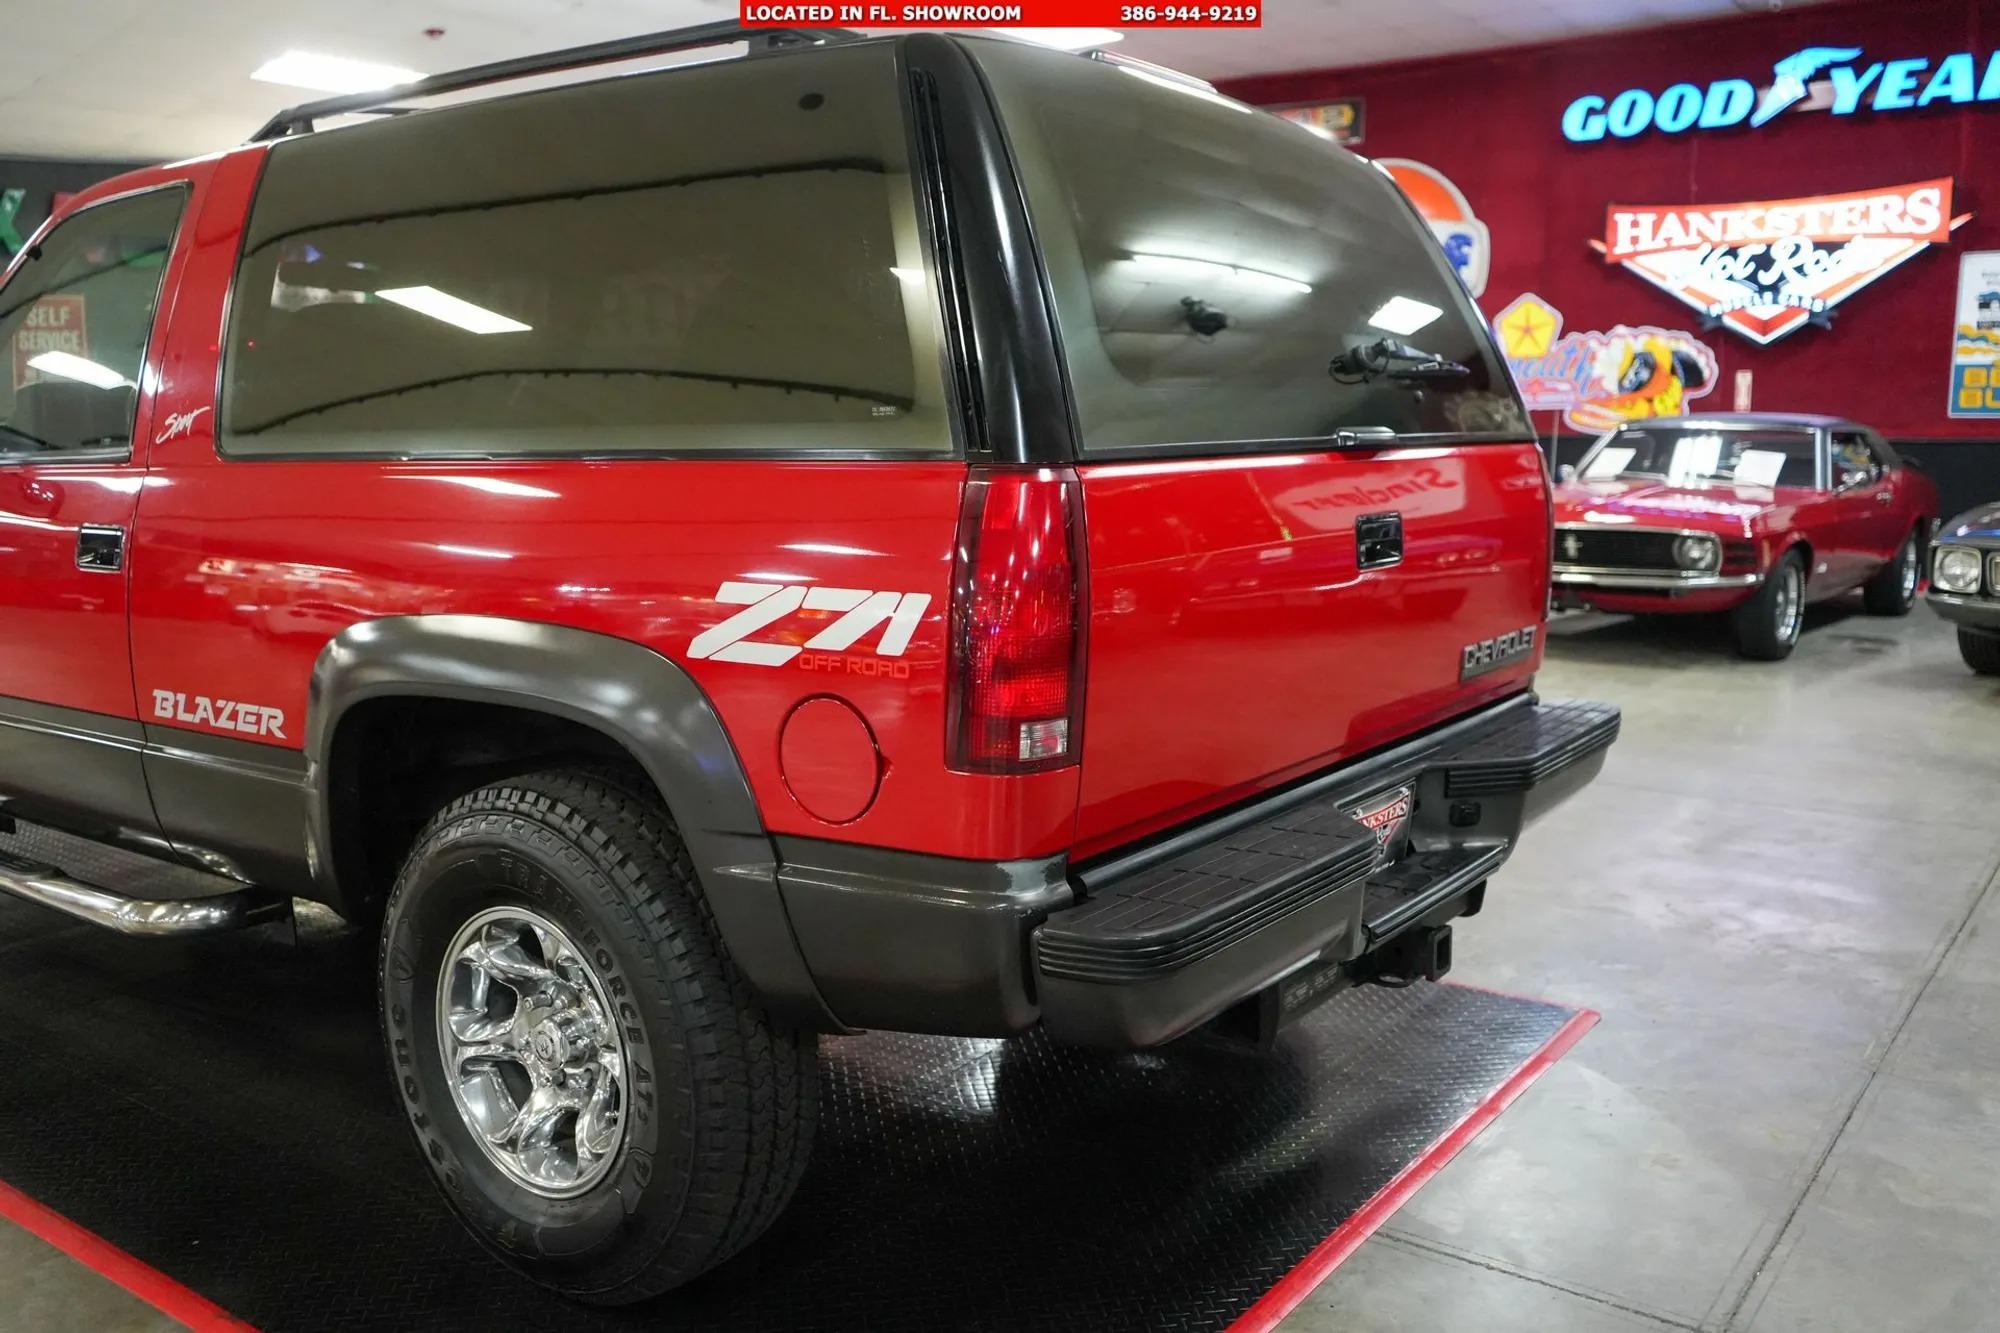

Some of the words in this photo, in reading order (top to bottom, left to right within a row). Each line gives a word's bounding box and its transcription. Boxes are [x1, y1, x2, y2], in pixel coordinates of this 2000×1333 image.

[1561, 78, 1756, 143] GOOD
[1613, 188, 1942, 254] HANKSTERS
[19, 328, 80, 351] SERVICE
[26, 305, 70, 328] SELF
[686, 581, 932, 667] Z71
[1463, 625, 1538, 669] CHEVROLET
[801, 655, 839, 673] OFF
[847, 658, 909, 680] ROAD
[152, 688, 288, 740] BLAZER
